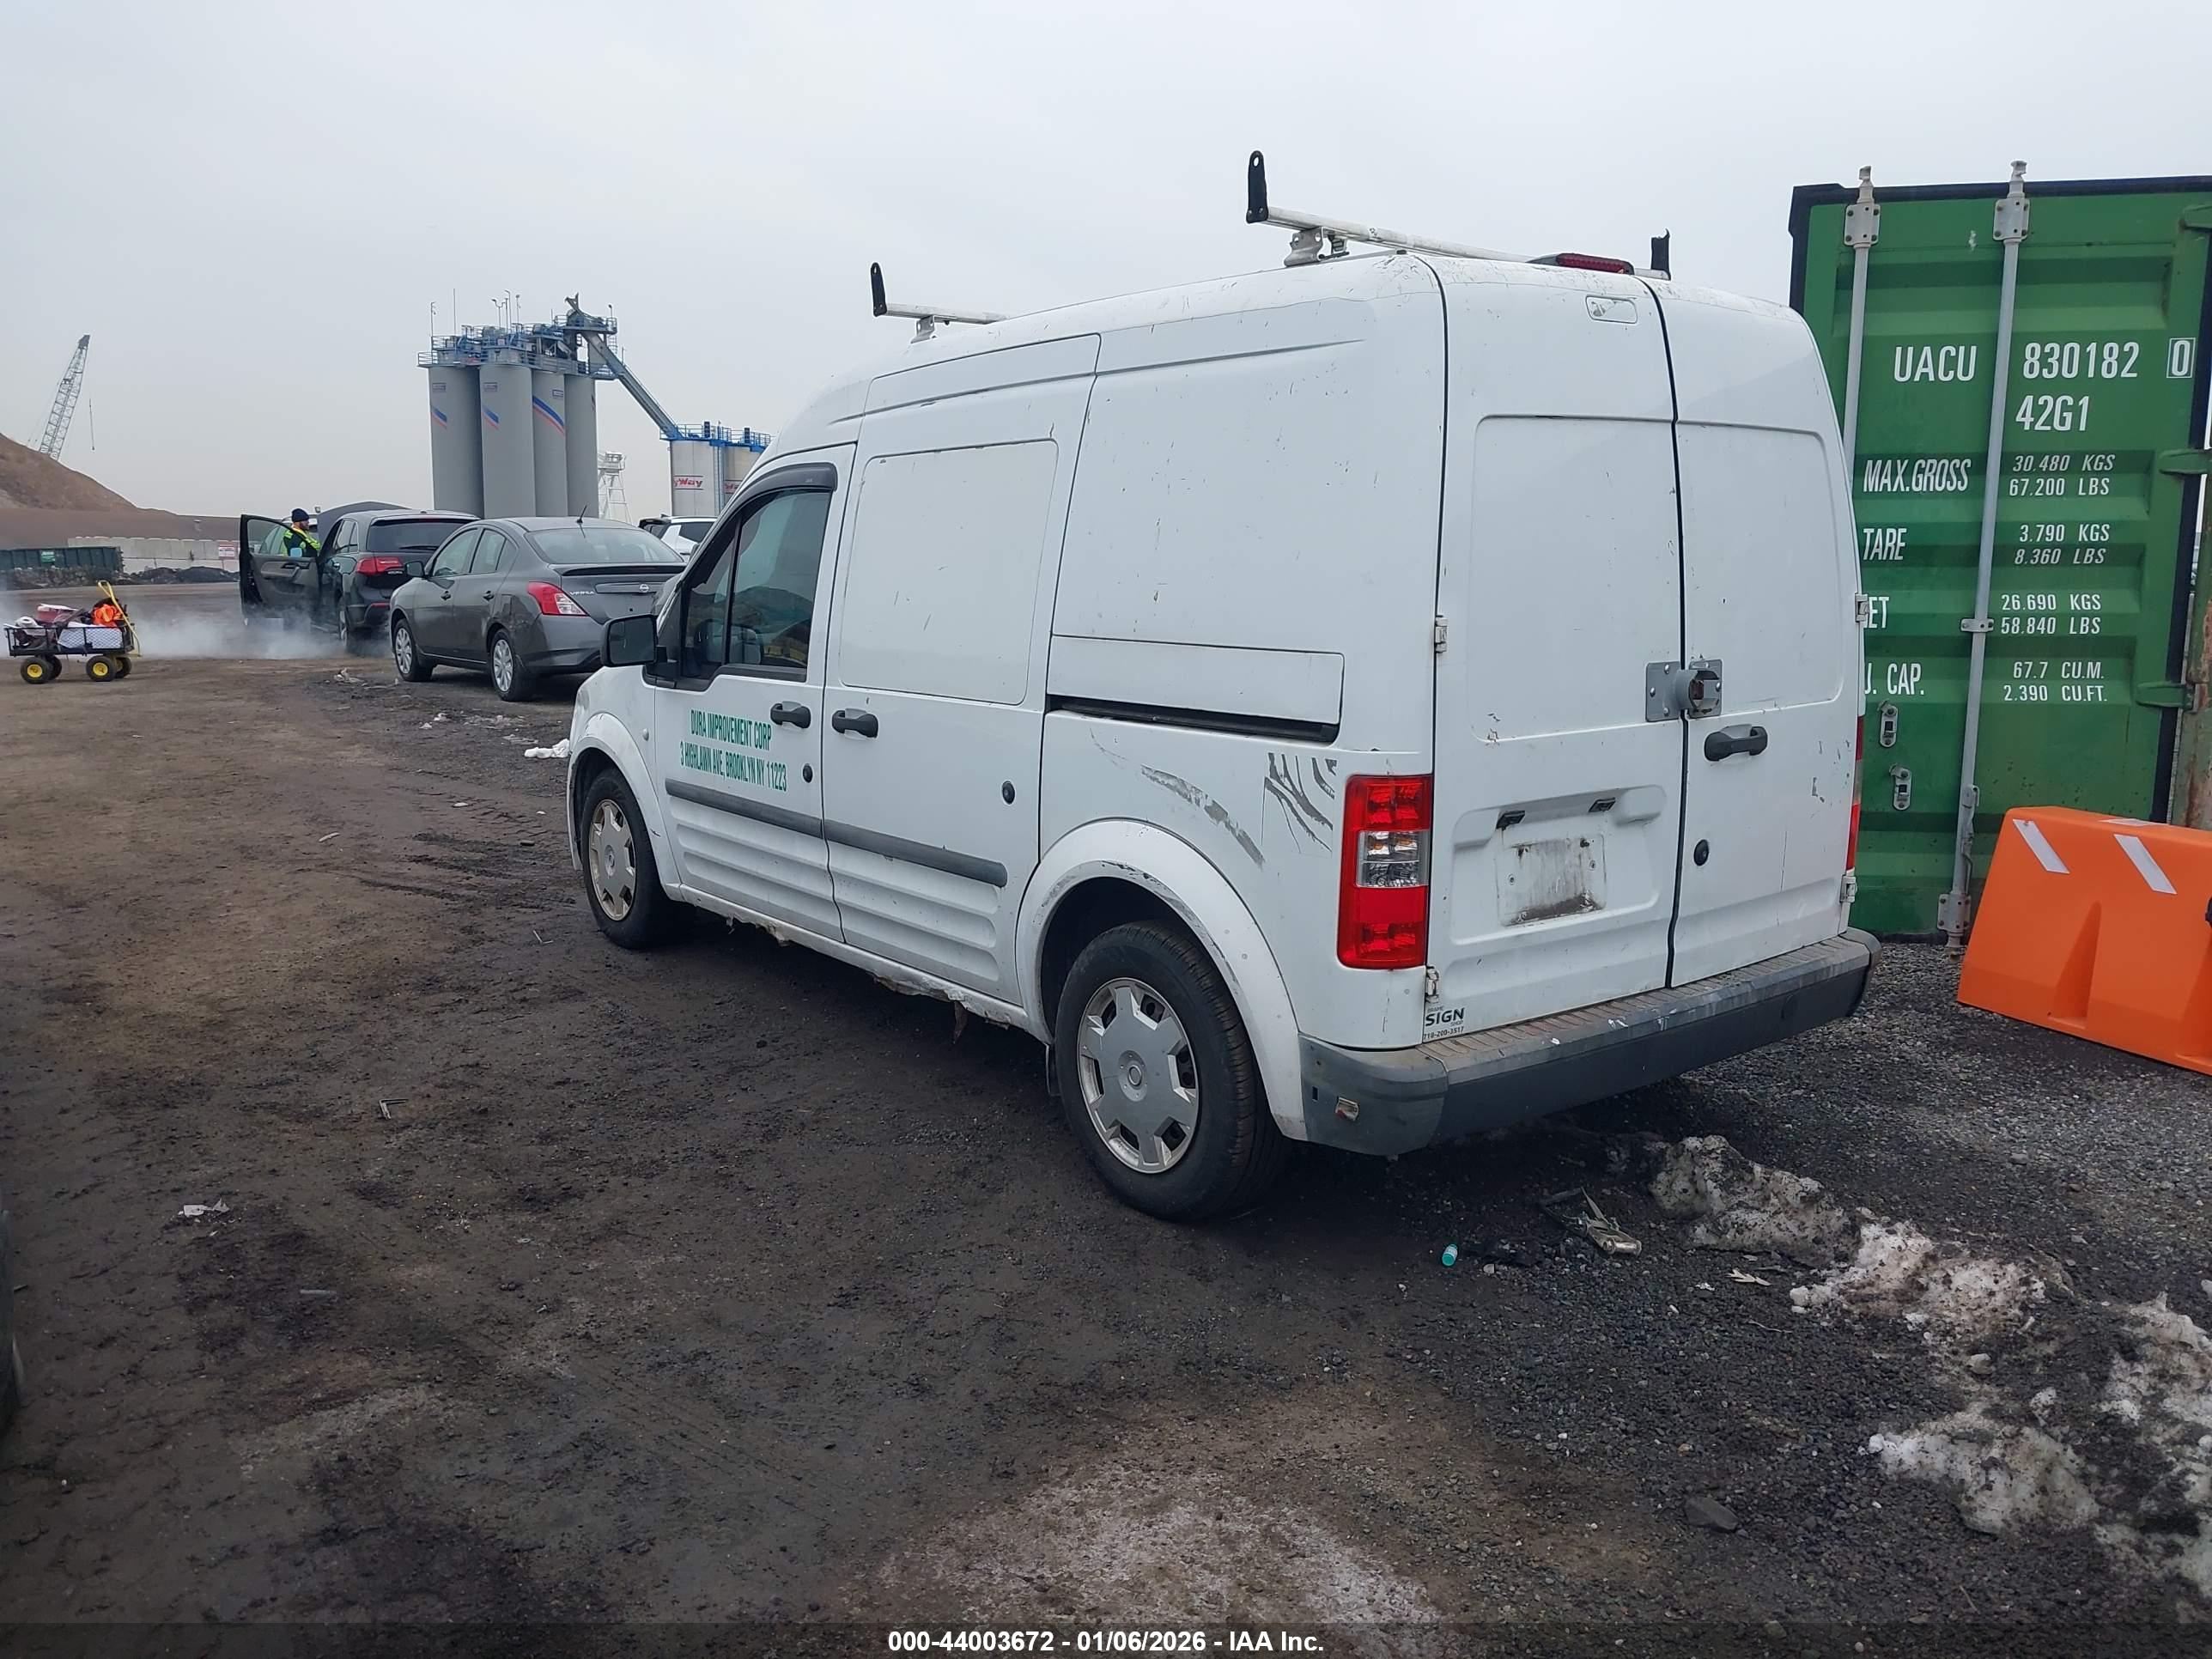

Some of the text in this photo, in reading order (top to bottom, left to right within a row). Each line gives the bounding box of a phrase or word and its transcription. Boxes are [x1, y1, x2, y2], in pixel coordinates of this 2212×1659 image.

[1893, 340, 2189, 382] UACU 830182 0
[2015, 395, 2089, 431] 42G1
[1863, 454, 2116, 493] MAX.GROSS 30.480 KGS
[2009, 477, 2110, 496] 67.200 LBS
[1863, 524, 2110, 561] TARE 3.790 KGS
[2014, 548, 2106, 565] 8.360 LBS
[1867, 593, 2101, 629] ET 26.690 KGS
[2001, 617, 2101, 635] 58.840 LBS
[1887, 663, 1924, 696] CAP.
[2013, 661, 2048, 679] 67.7
[2061, 661, 2104, 679] CU.M.
[2003, 684, 2107, 702] 2.390 CU.FT.
[690, 709, 772, 750] DURA IMPROVEMENT CORP
[726, 751, 757, 784] BROOKLYN
[757, 758, 766, 787] NY
[766, 762, 787, 792] 11223
[1425, 1007, 1465, 1026] SIGN
